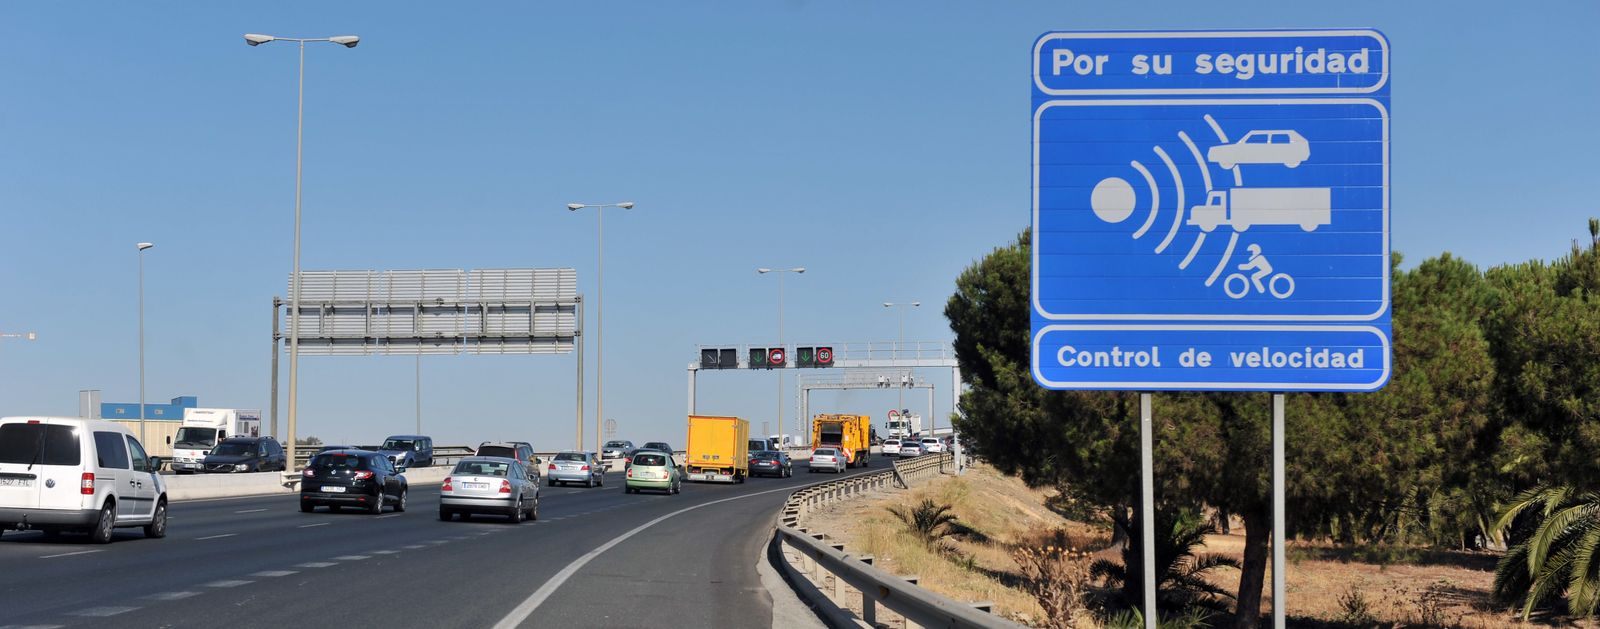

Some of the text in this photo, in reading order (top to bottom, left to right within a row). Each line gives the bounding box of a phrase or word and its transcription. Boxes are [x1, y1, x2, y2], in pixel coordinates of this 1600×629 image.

[1053, 46, 1369, 80] Por su seguridad
[820, 351, 829, 359] 60
[1057, 345, 1364, 368] Control de velocidad
